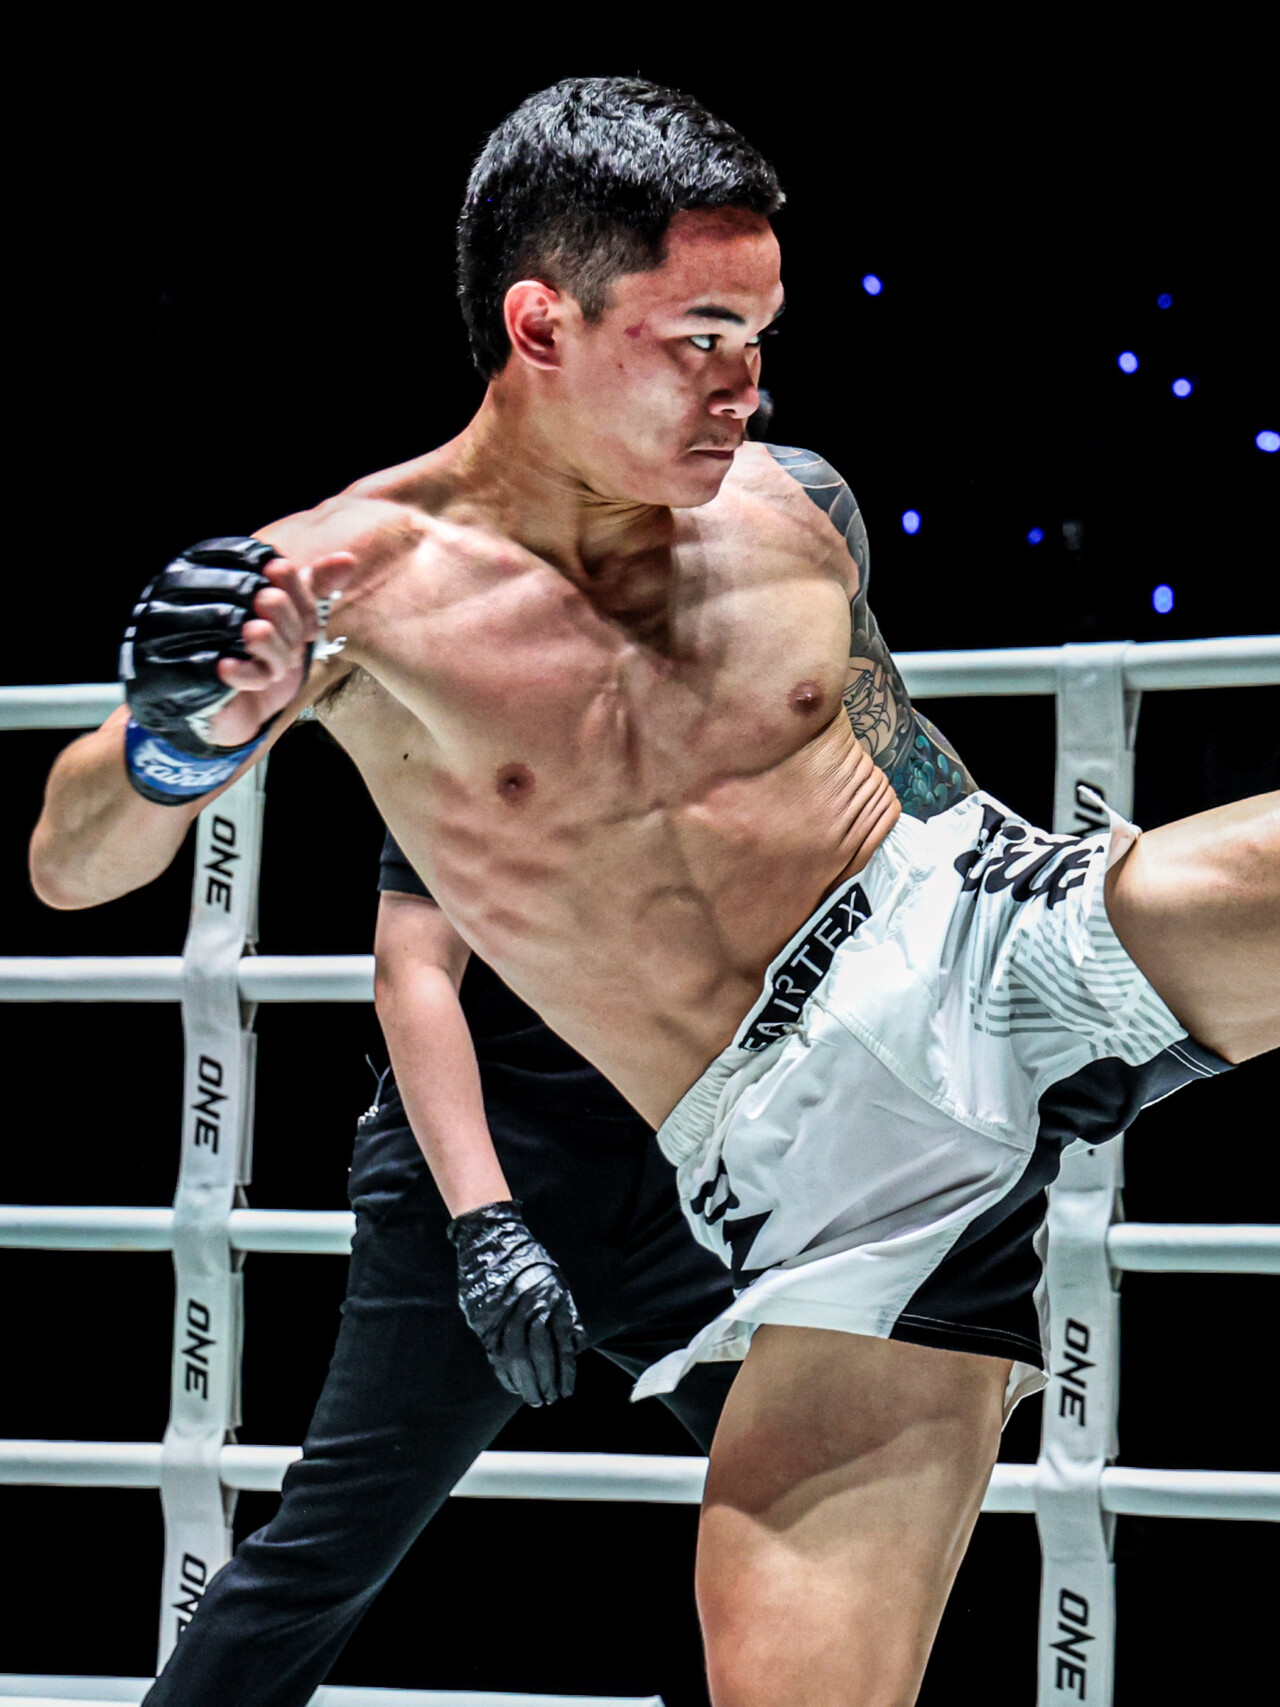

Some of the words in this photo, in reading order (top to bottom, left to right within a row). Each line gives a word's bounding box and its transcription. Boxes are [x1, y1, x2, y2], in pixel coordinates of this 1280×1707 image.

[1064, 779, 1111, 838] ON
[204, 815, 241, 914] ONE
[190, 1055, 229, 1155] ONE
[180, 1298, 217, 1400] ONE
[1056, 1317, 1097, 1427] ONE
[1049, 1588, 1097, 1701] ONE
